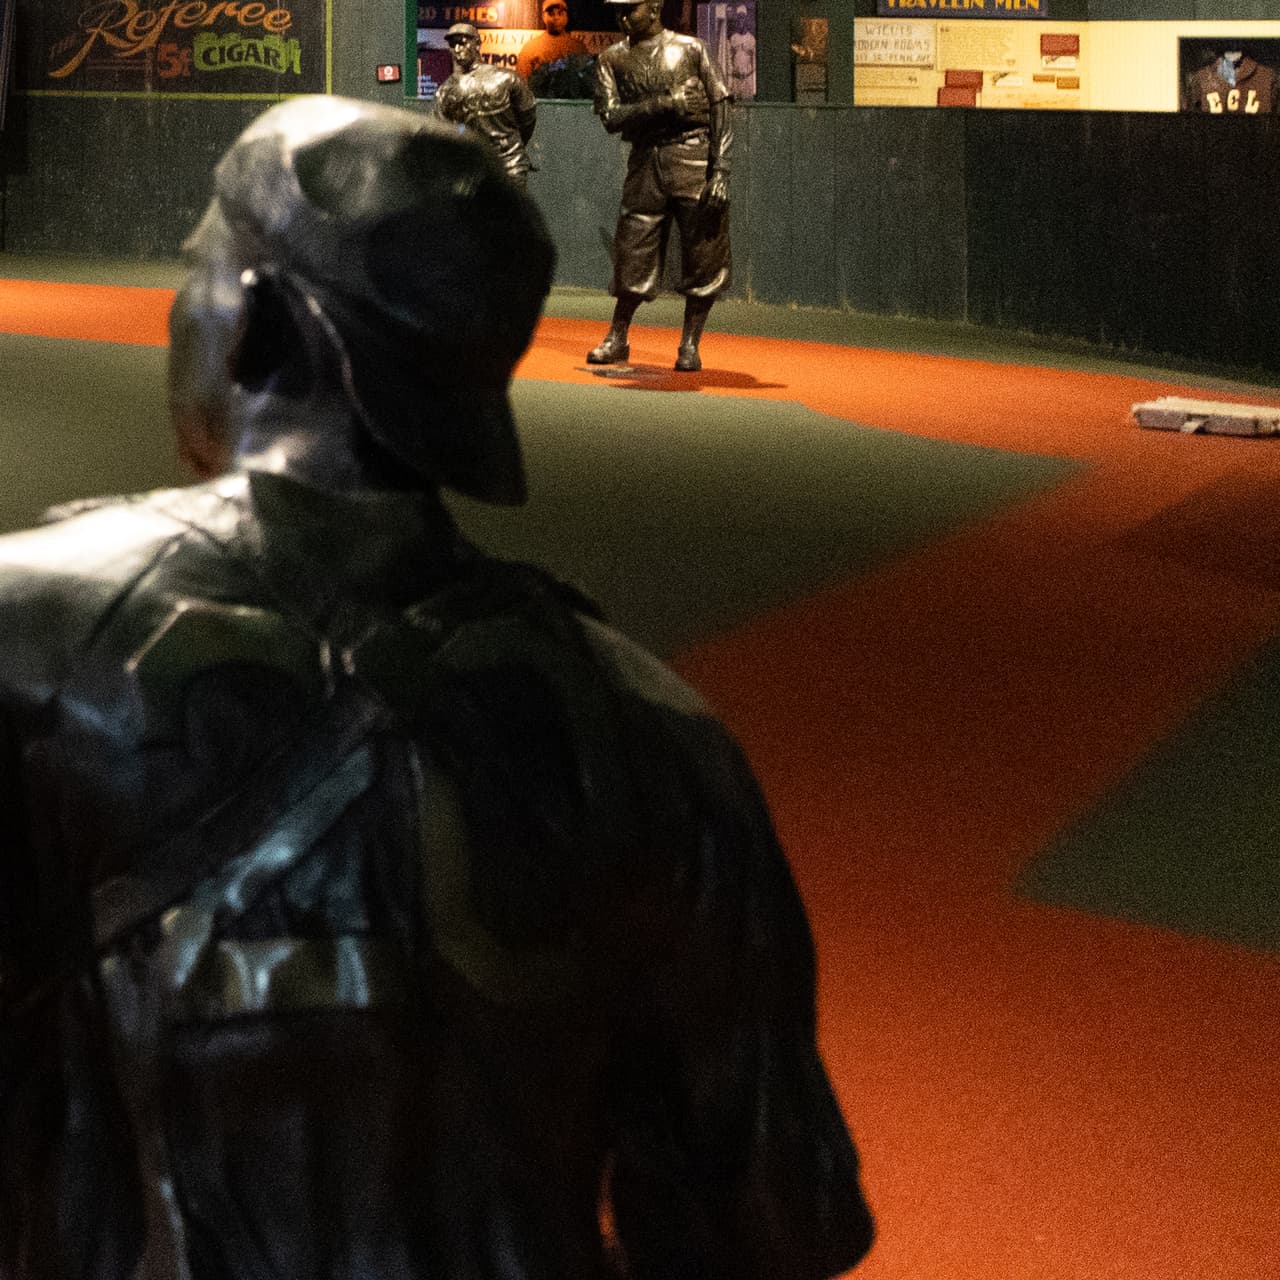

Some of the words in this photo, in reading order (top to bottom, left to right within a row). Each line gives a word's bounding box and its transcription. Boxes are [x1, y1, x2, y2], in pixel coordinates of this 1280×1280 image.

[443, 5, 498, 22] TIMES
[202, 42, 282, 66] CIGAR
[1206, 89, 1260, 114] ECL
